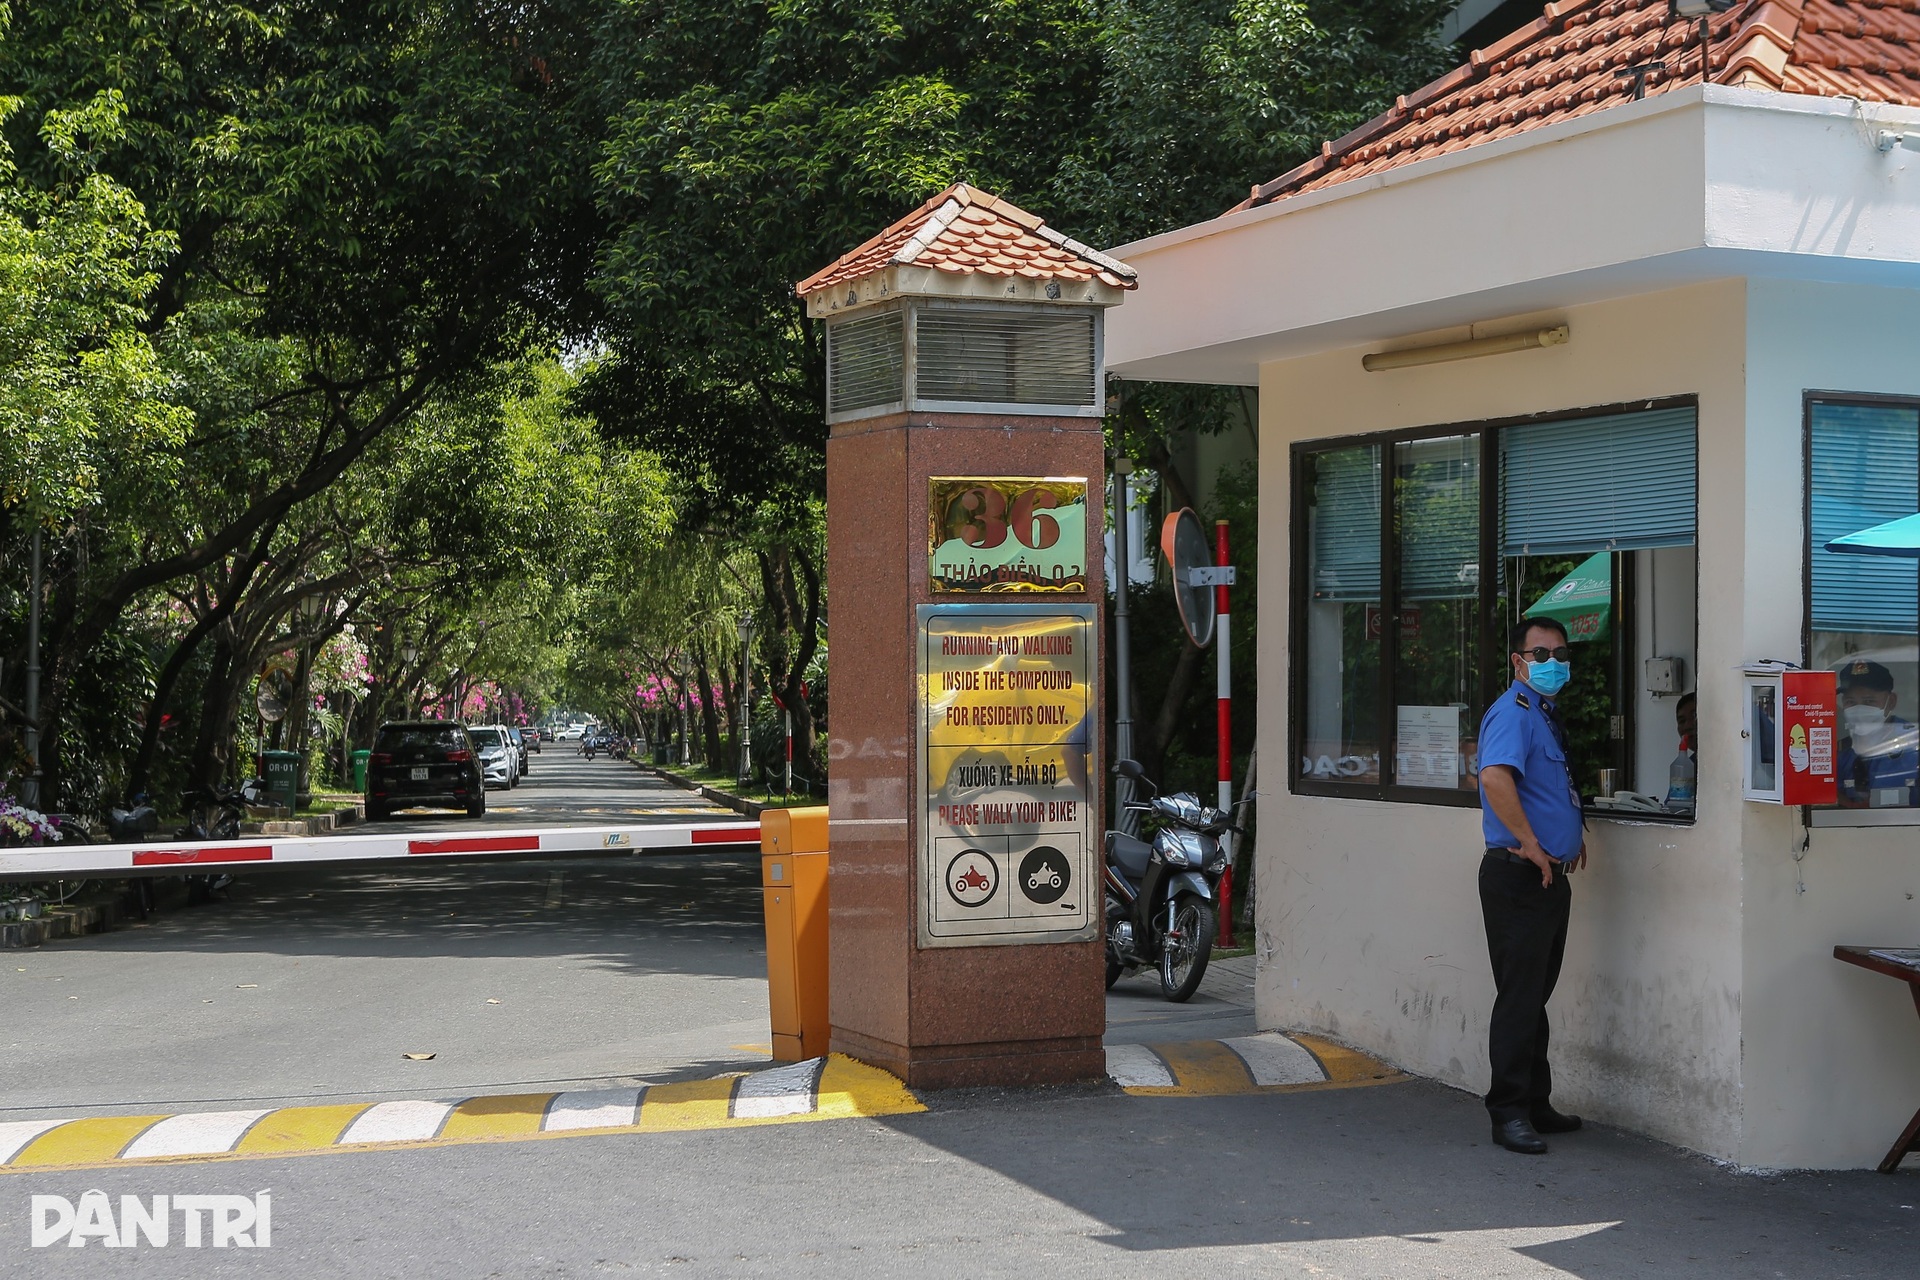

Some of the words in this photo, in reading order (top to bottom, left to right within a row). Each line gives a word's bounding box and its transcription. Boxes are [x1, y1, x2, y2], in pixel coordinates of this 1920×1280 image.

[961, 488, 1060, 549] 36
[940, 557, 991, 582] THẢO
[942, 635, 993, 656] RUNNING
[996, 635, 1019, 655] AND
[1023, 635, 1072, 655] WALKING
[942, 671, 980, 691] INSIDE
[983, 671, 1005, 690] THE
[1008, 670, 1072, 690] COMPOUND
[946, 706, 969, 726] FOR
[972, 706, 1033, 726] RESIDENTS
[1037, 705, 1069, 725] ONLY.
[959, 758, 996, 787] XUỐNG
[999, 765, 1013, 786] XE
[1016, 756, 1038, 786] DẪN
[1042, 758, 1056, 790] BỘ
[939, 804, 979, 826] PLEASE
[982, 803, 1013, 824] WALK
[1016, 802, 1045, 824] YOUR
[1048, 801, 1077, 822] BIKE!
